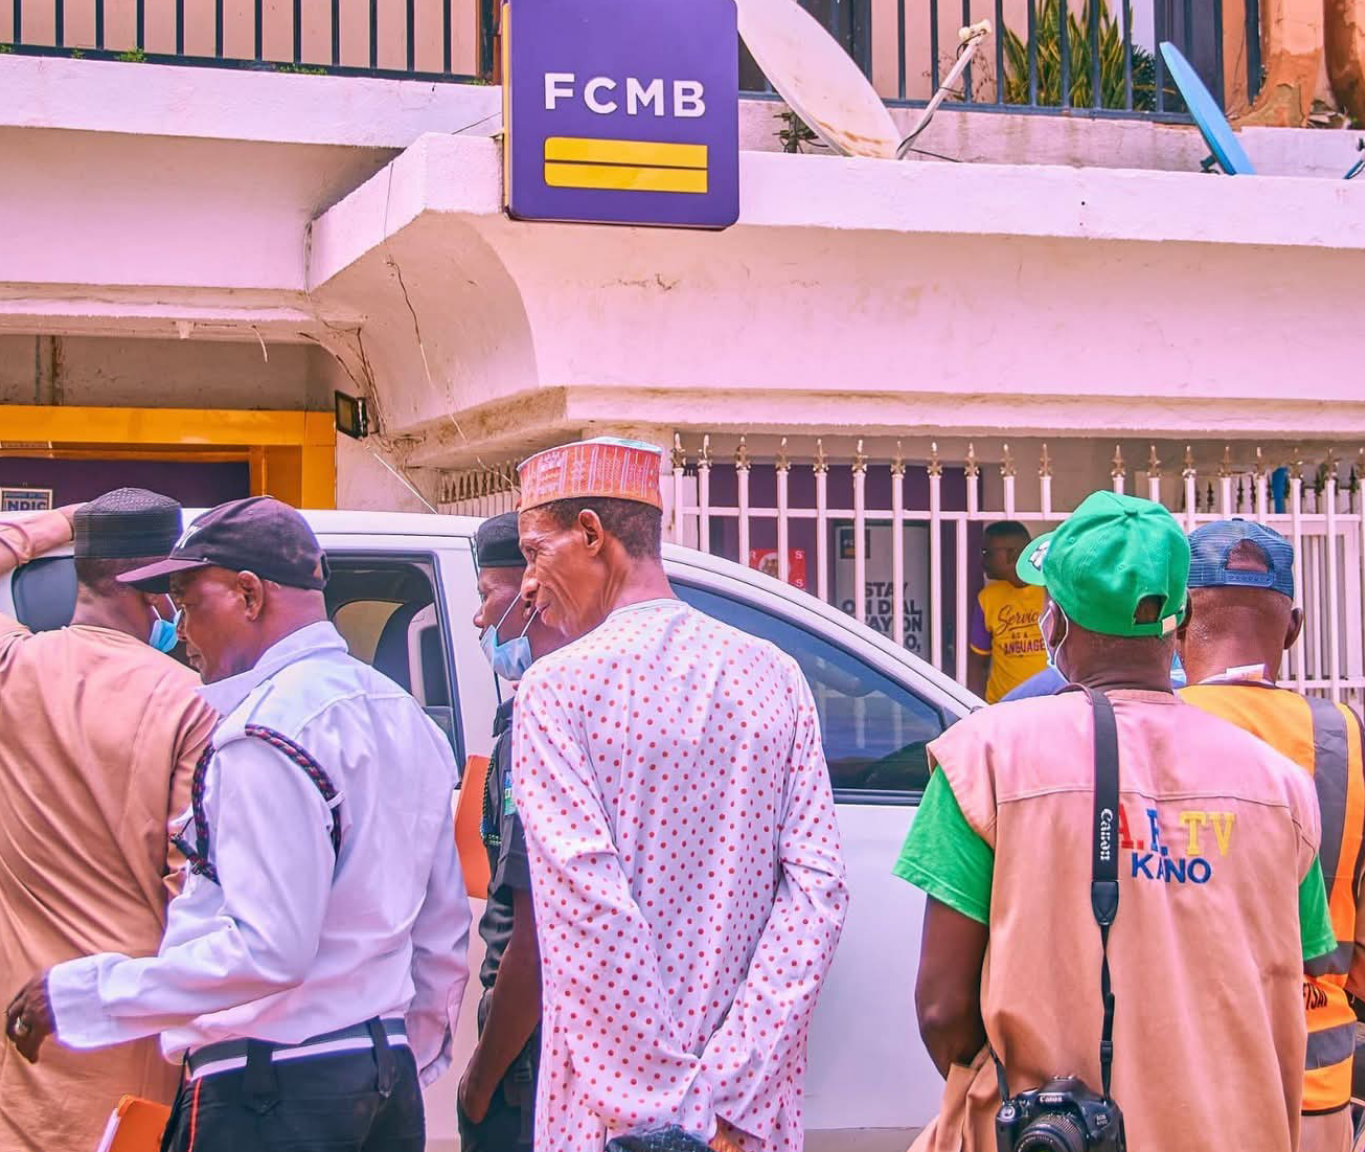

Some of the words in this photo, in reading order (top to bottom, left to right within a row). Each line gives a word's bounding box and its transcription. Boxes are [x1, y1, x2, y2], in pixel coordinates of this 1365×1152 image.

[544, 72, 706, 118] FCMB
[1100, 808, 1113, 861] Canon
[1179, 811, 1237, 858] TV
